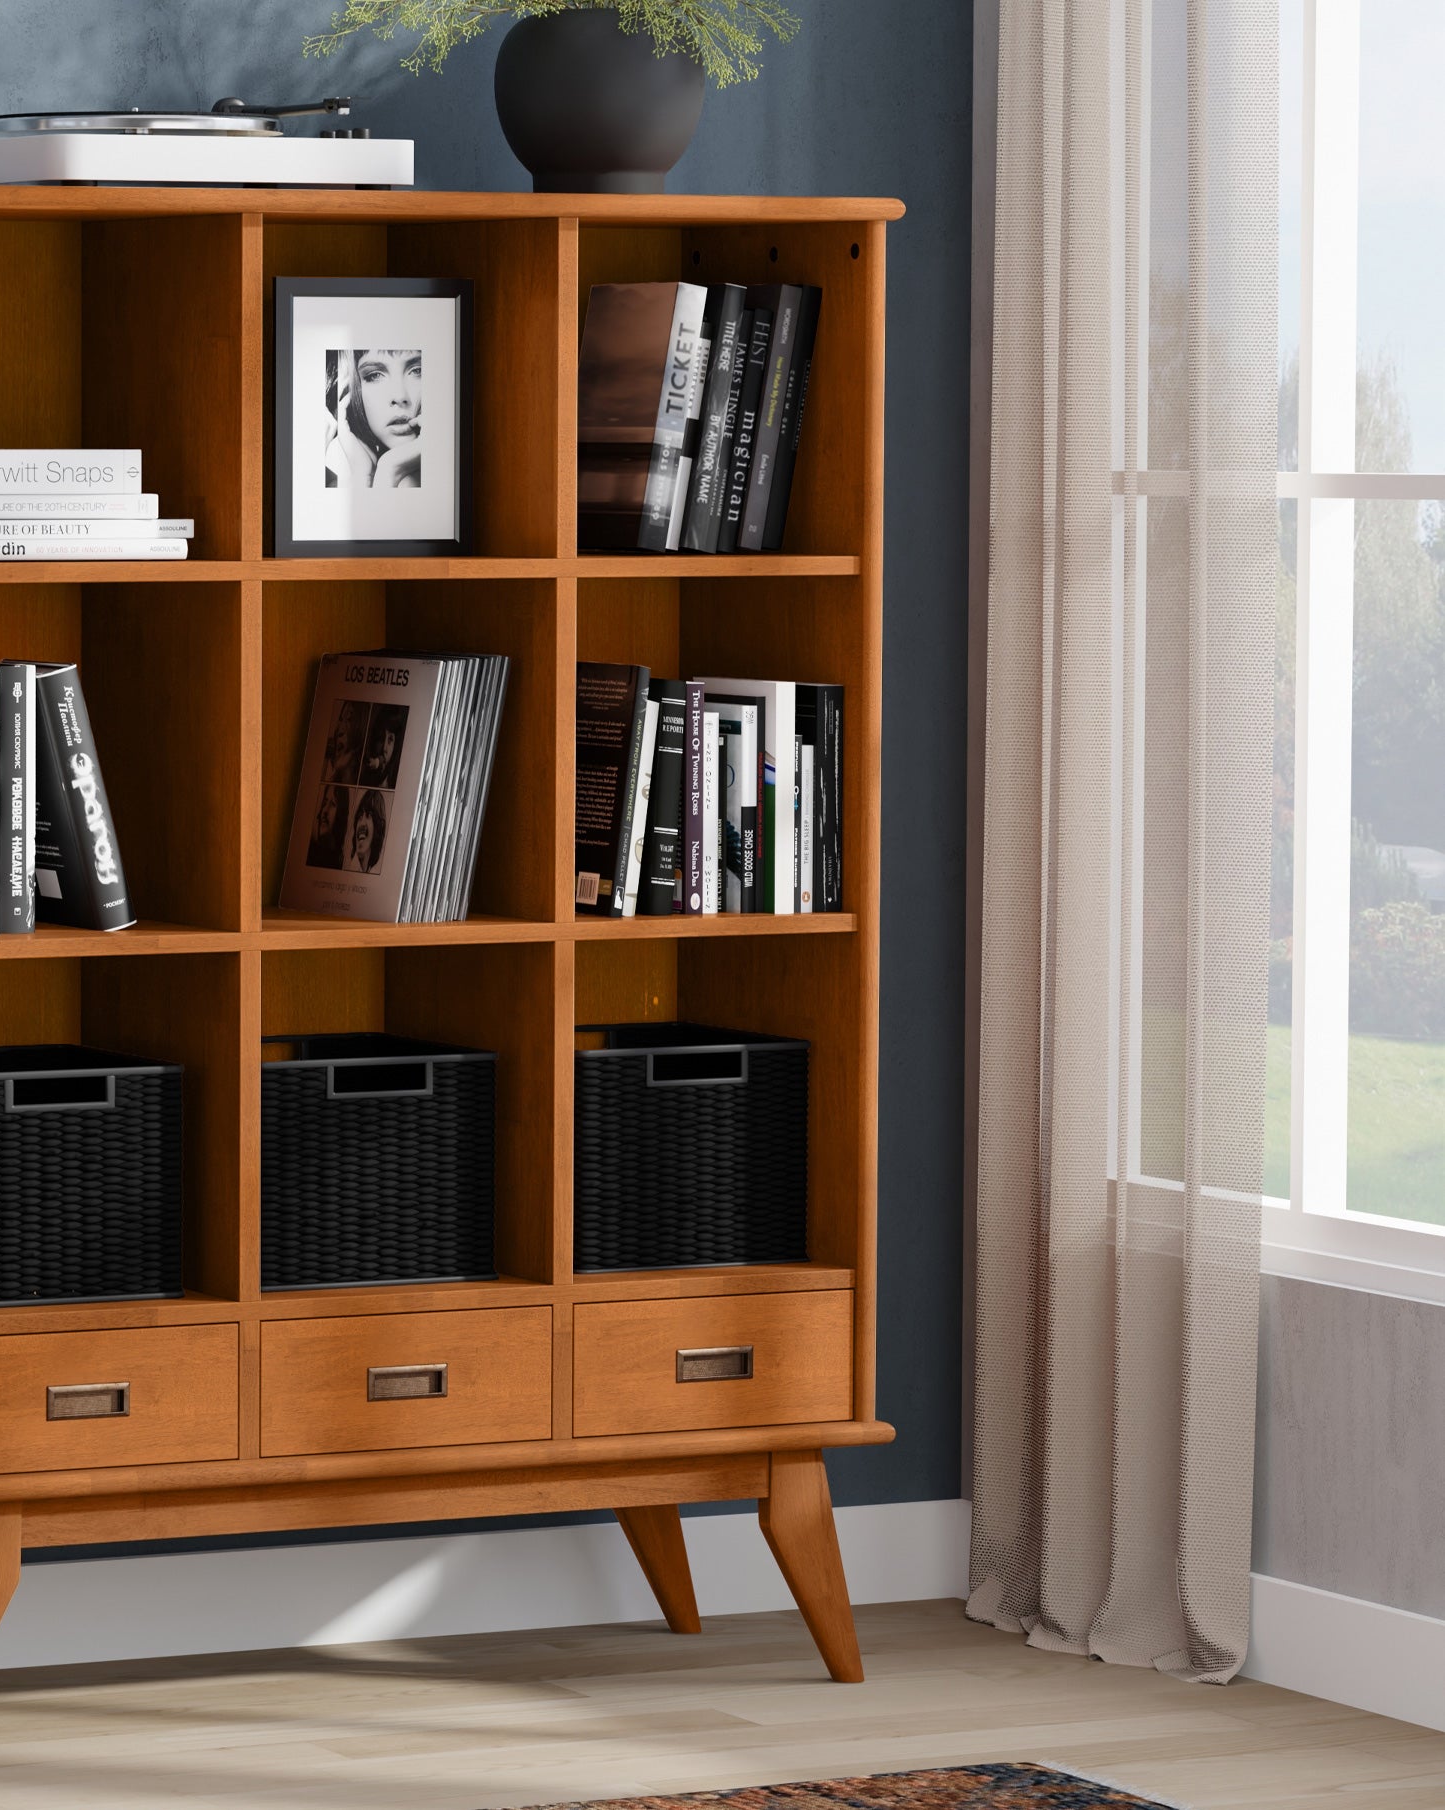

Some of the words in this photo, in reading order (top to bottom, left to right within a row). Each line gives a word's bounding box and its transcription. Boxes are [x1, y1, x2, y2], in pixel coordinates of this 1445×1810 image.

[722, 321, 736, 345] TITLE
[749, 320, 771, 370] FEIST
[665, 322, 696, 415] TICKET
[718, 346, 730, 372] HERE
[733, 342, 747, 383] JAMES
[709, 414, 721, 426] BY
[723, 389, 740, 439] TINGLE
[659, 435, 673, 471] STONE
[702, 430, 718, 470] AUTHOR
[46, 460, 114, 487] Snaps
[727, 410, 755, 522] magician
[697, 474, 711, 504] NAME
[15, 503, 27, 513] OF
[28, 503, 43, 513] THE
[43, 503, 67, 513] 20TH
[66, 503, 107, 512] CENTURY
[21, 525, 39, 535] OF
[41, 524, 92, 535] BEAUTY
[345, 665, 364, 683] LOS
[366, 666, 410, 687] BEATLES
[692, 690, 701, 707] THE
[58, 702, 73, 747] Паолини
[64, 686, 83, 744] Кристофер
[692, 711, 700, 736] HOUSE
[635, 718, 643, 743] AWAY
[632, 744, 640, 765] FROM
[692, 738, 701, 751] OF
[691, 753, 700, 790] TWINING
[625, 766, 638, 822] EVERYWHERE
[691, 791, 700, 816] ROSES
[744, 829, 754, 849] CHASE
[691, 841, 700, 870] Nabina
[744, 850, 754, 870] GOOSE
[691, 871, 699, 886] Das
[744, 872, 754, 888] WILD
